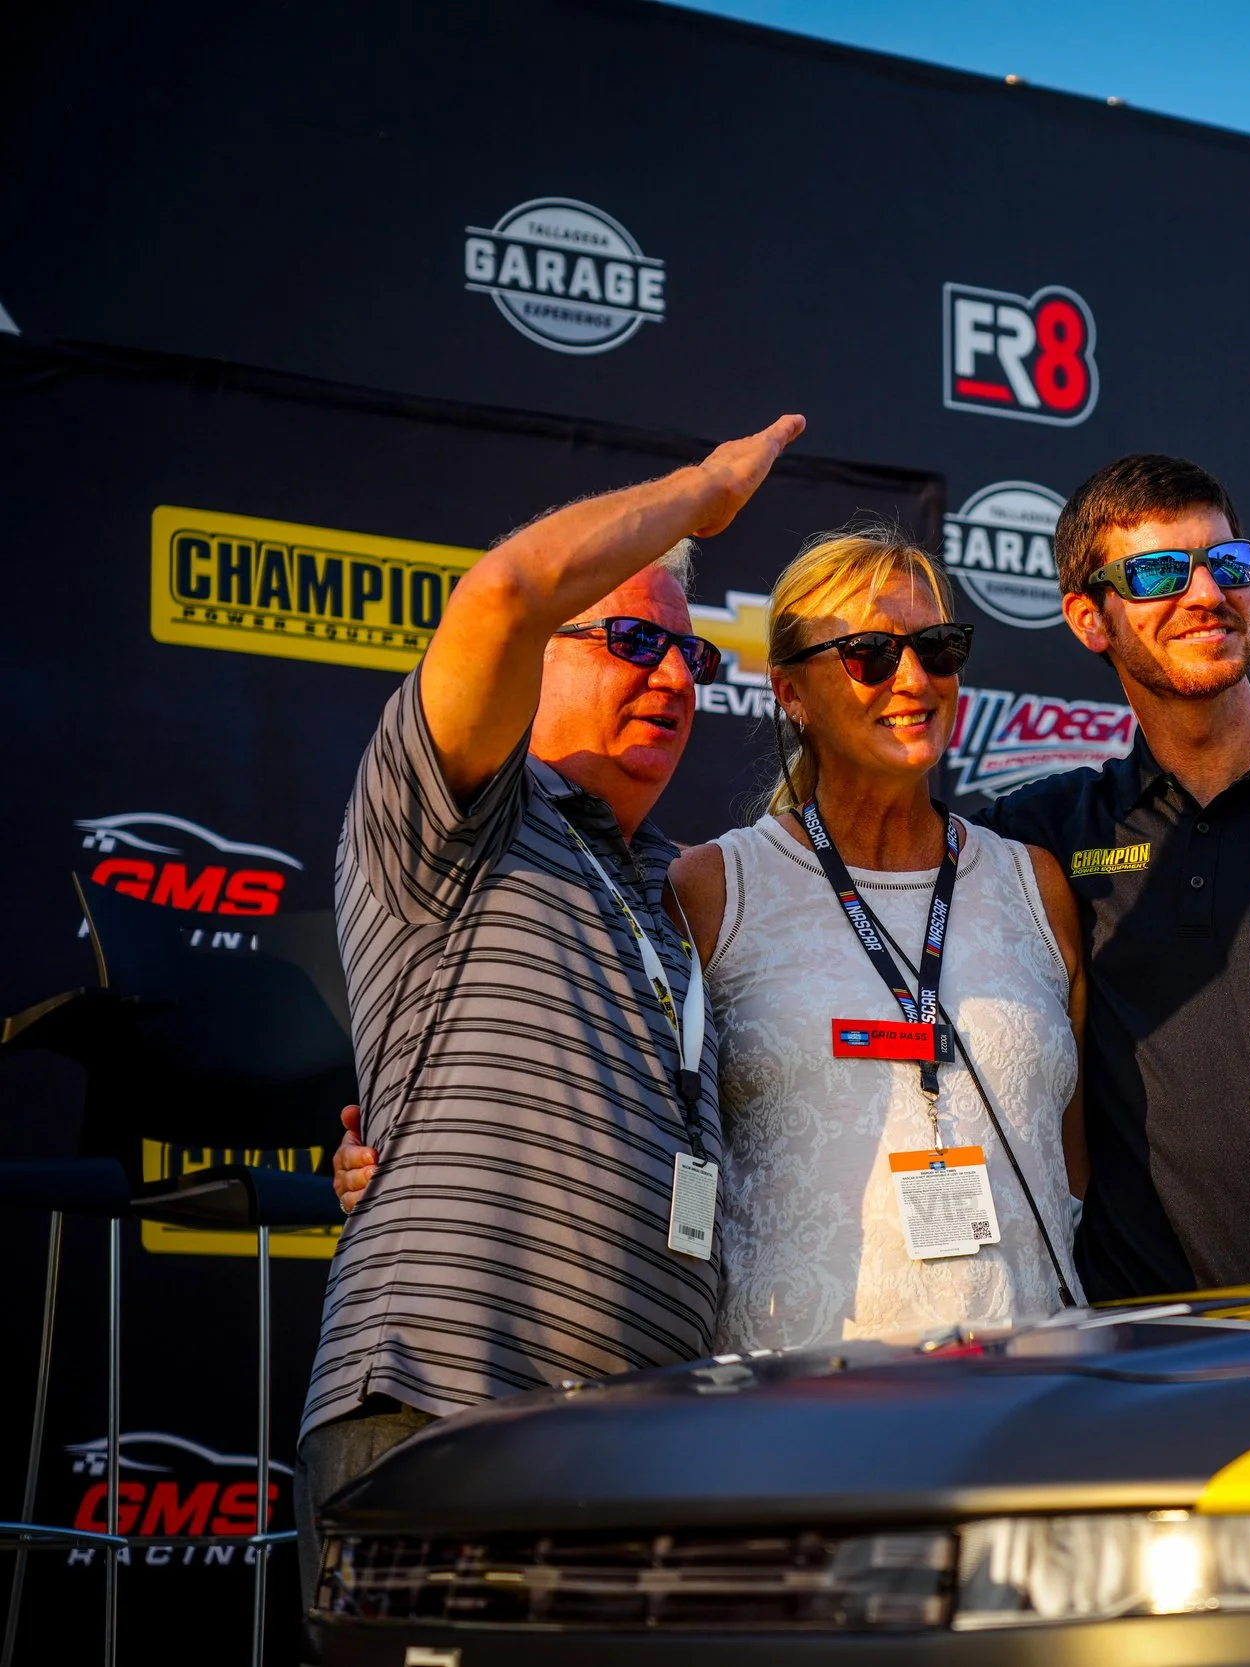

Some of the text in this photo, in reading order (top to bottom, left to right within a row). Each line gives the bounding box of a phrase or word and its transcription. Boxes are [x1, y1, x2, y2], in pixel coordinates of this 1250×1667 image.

[464, 236, 666, 311] GARAGE
[955, 298, 1088, 412] FR8
[943, 522, 1056, 578] GARA
[175, 535, 461, 631] CHAMPIO
[182, 607, 431, 648] POWER EQUIPM
[803, 807, 831, 850] NASCAR
[1073, 844, 1149, 869] CHAMPION
[1073, 867, 1100, 875] POWER
[846, 904, 883, 952] NASCAR
[927, 898, 949, 945] NASCAR
[920, 989, 937, 1025] SCAR
[871, 1030, 897, 1039] GRID
[900, 1032, 927, 1041] PASS
[72, 1480, 279, 1537] GMS
